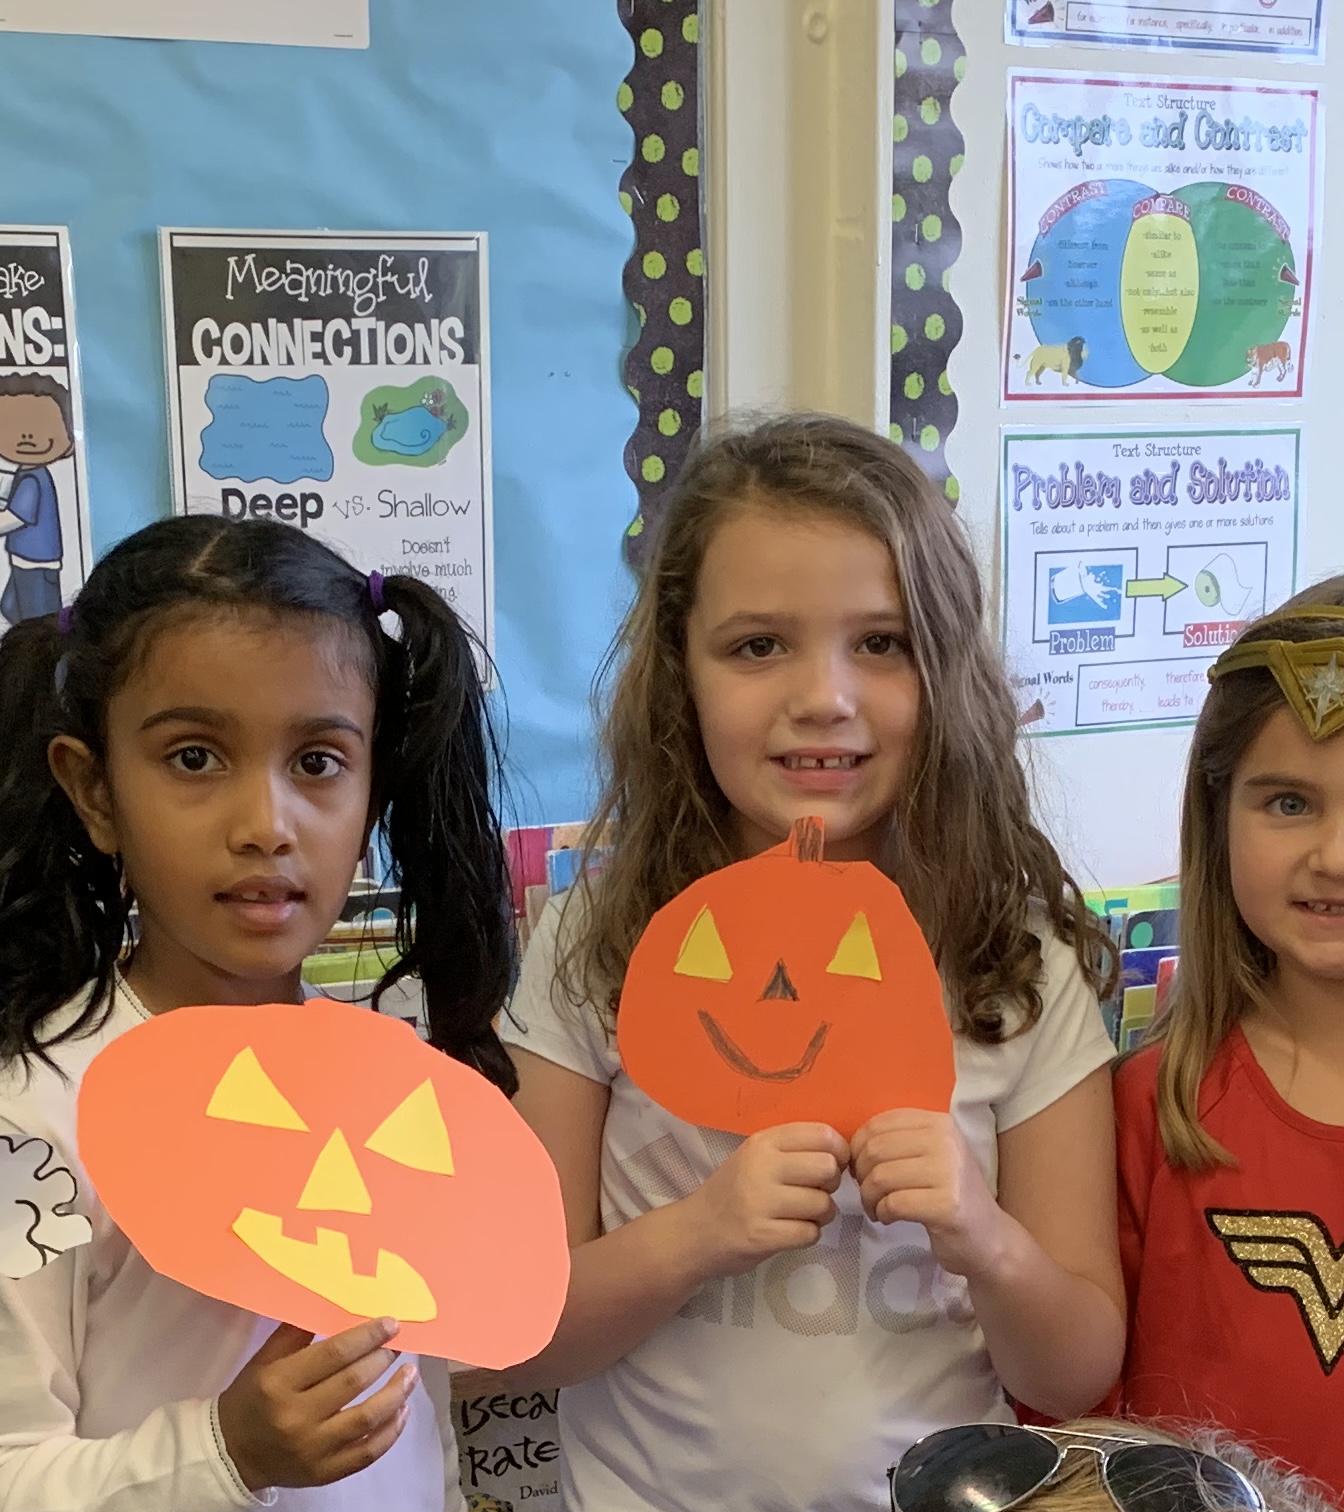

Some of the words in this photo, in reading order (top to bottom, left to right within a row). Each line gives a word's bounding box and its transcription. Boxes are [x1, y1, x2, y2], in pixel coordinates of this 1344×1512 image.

[1124, 93, 1152, 109] Text
[1157, 94, 1216, 111] Structure
[1021, 101, 1132, 156] Compare
[1140, 111, 1188, 151] and
[1194, 109, 1308, 154] Contrast
[1064, 158, 1079, 169] how
[1209, 163, 1224, 174] how
[1038, 182, 1106, 235] CONTRAST
[1133, 198, 1190, 219] COMPARE
[1227, 186, 1290, 240] CONTRAST
[225, 254, 433, 317] Meaningful
[192, 317, 464, 366] CONNECTIONS
[1113, 444, 1140, 458] Text
[1145, 443, 1201, 457] Structure
[1012, 460, 1122, 511] Problem
[1129, 459, 1180, 505] and
[1187, 457, 1291, 504] Solution
[221, 487, 324, 528] Deep
[331, 495, 371, 519] vs.
[378, 489, 471, 519] Shallow
[1030, 520, 1048, 536] Tells
[1051, 518, 1075, 535] about
[1079, 524, 1085, 533] a
[1087, 519, 1119, 537] problem
[1122, 517, 1140, 532] and
[1142, 517, 1162, 530] then
[1165, 517, 1186, 535] gives
[1189, 519, 1203, 528] one
[1206, 519, 1214, 528] or
[1216, 517, 1237, 527] more
[1240, 515, 1274, 526] solutions
[402, 536, 451, 555] Doesn't
[381, 560, 430, 578] involve
[435, 557, 472, 577] much
[1050, 630, 1115, 654] Problem
[1044, 671, 1073, 684] Words
[1158, 696, 1181, 709] leads
[1184, 696, 1193, 706] to
[520, 1480, 559, 1500] David
